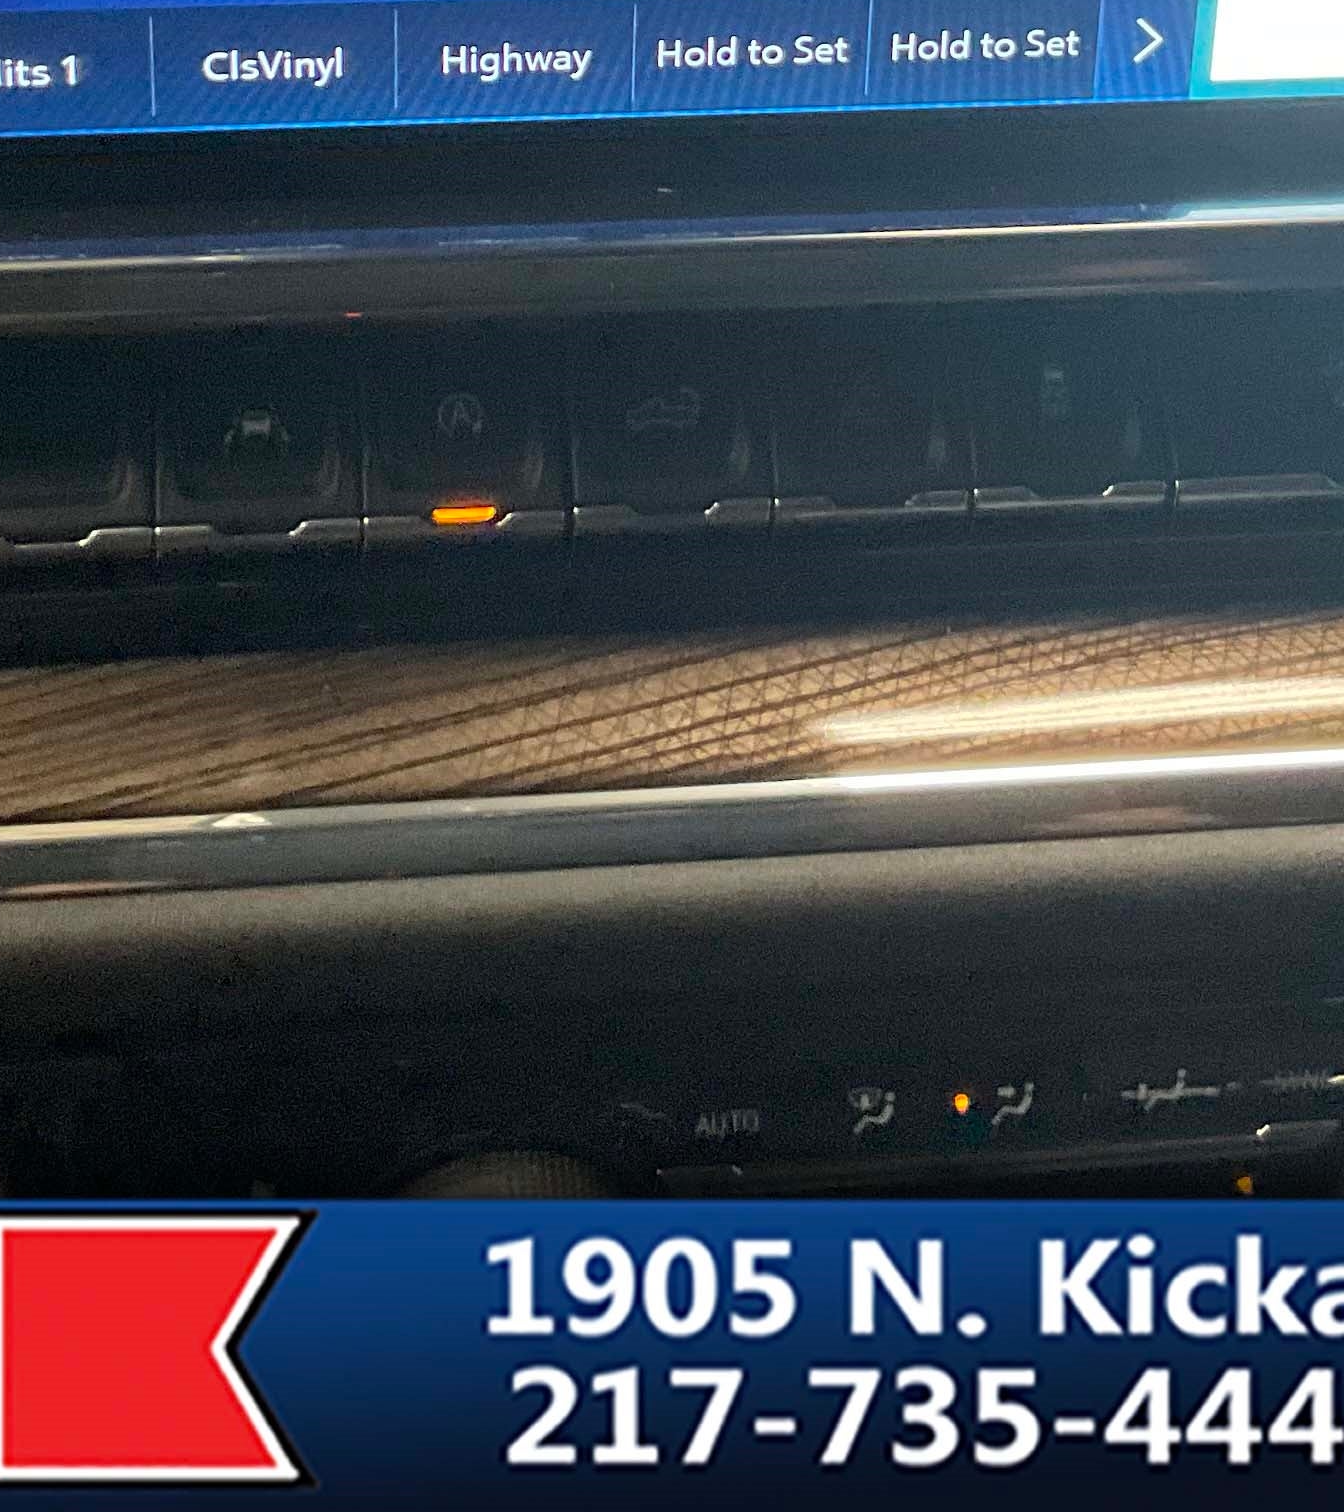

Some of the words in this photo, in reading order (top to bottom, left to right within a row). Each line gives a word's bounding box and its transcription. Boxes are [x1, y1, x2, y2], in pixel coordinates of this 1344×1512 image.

[441, 43, 592, 82] Highway
[656, 37, 736, 70] Hold
[748, 39, 783, 67] to
[793, 36, 849, 65] Set
[890, 30, 969, 62] Hold
[980, 32, 1015, 60] to
[1024, 29, 1080, 59] Set
[61, 54, 80, 85] 1
[202, 46, 344, 87] ClsVinyl
